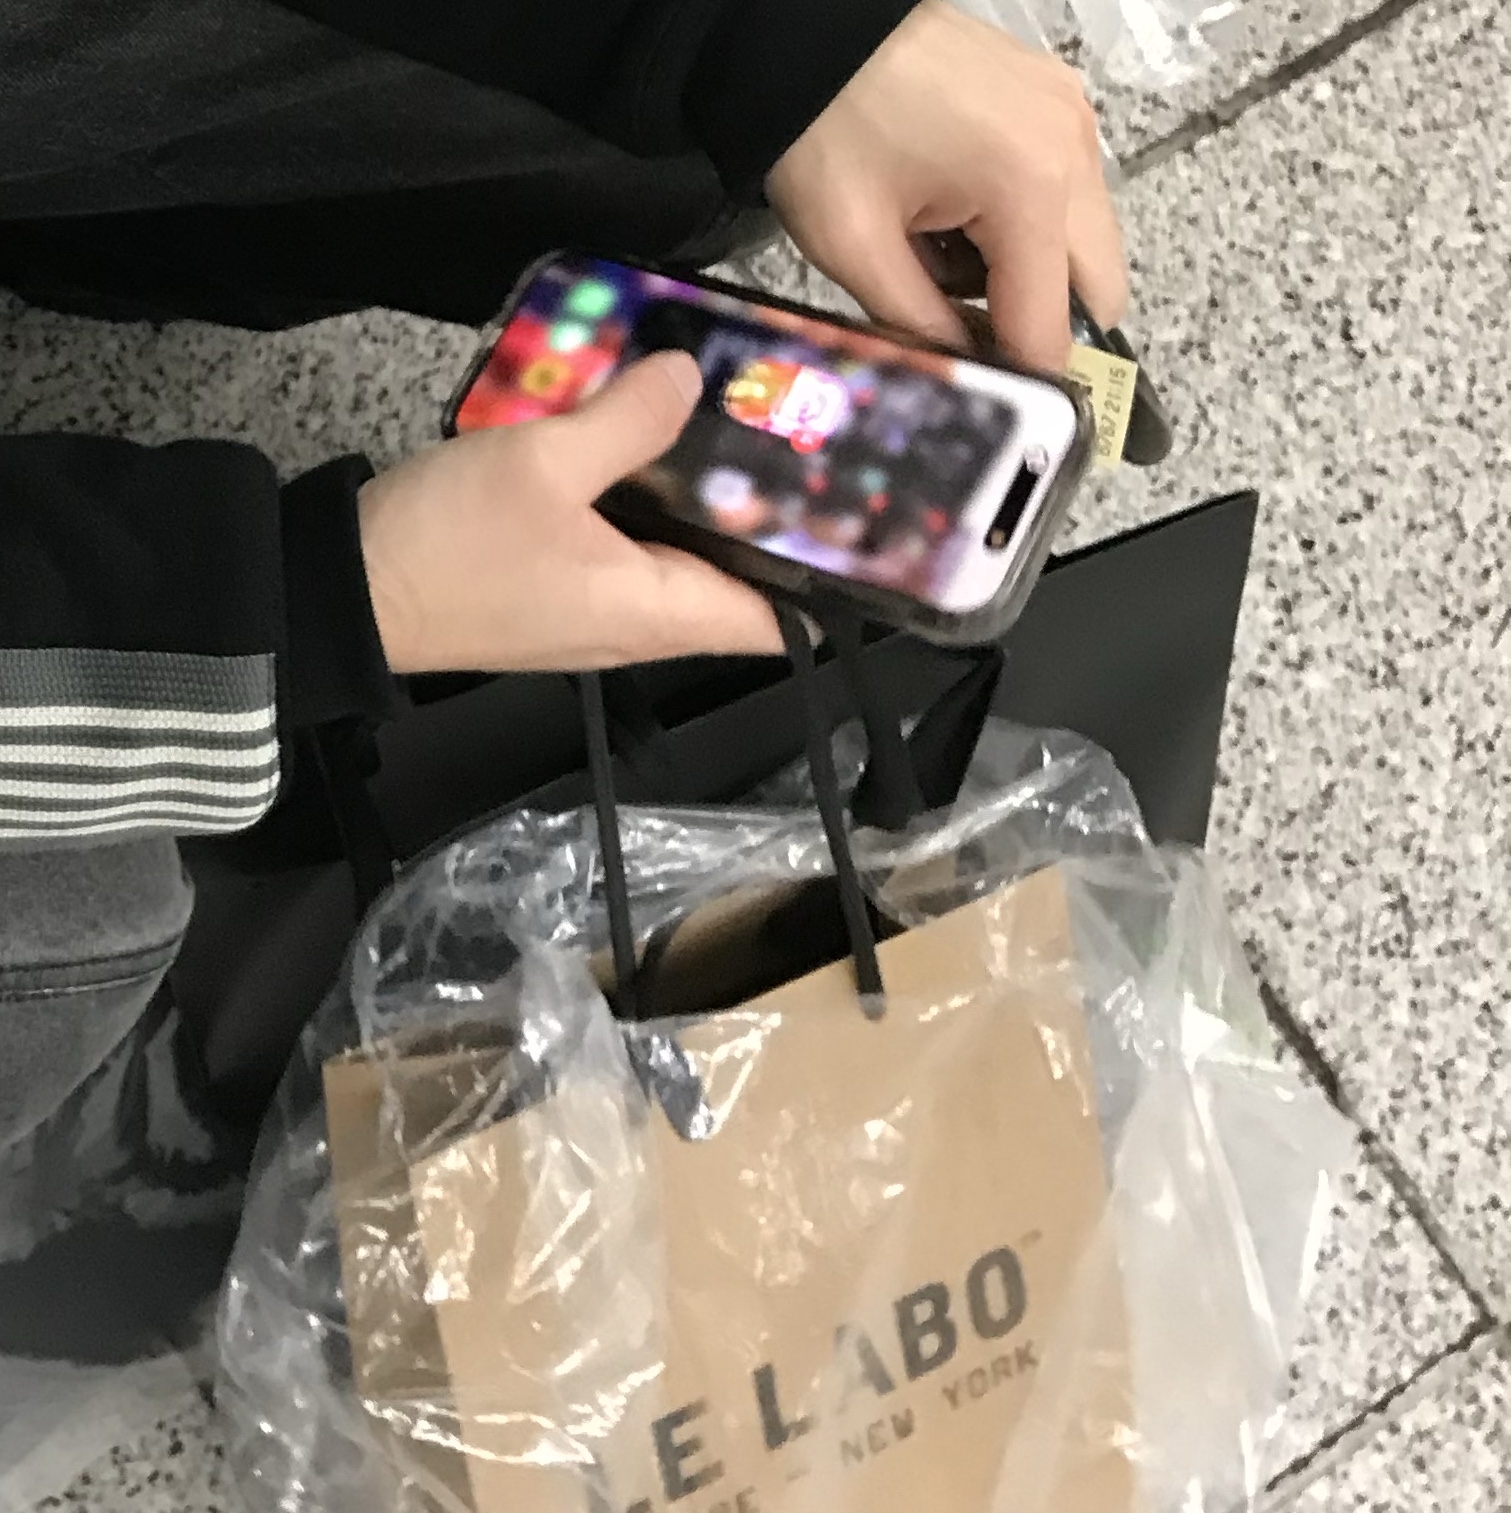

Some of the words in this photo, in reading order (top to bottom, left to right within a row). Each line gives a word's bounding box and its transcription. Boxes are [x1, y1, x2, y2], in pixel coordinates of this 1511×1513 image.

[626, 1398, 726, 1513] E
[751, 1243, 1027, 1451] LABO
[839, 1407, 916, 1467] NEW
[942, 1338, 1039, 1410] YORK
